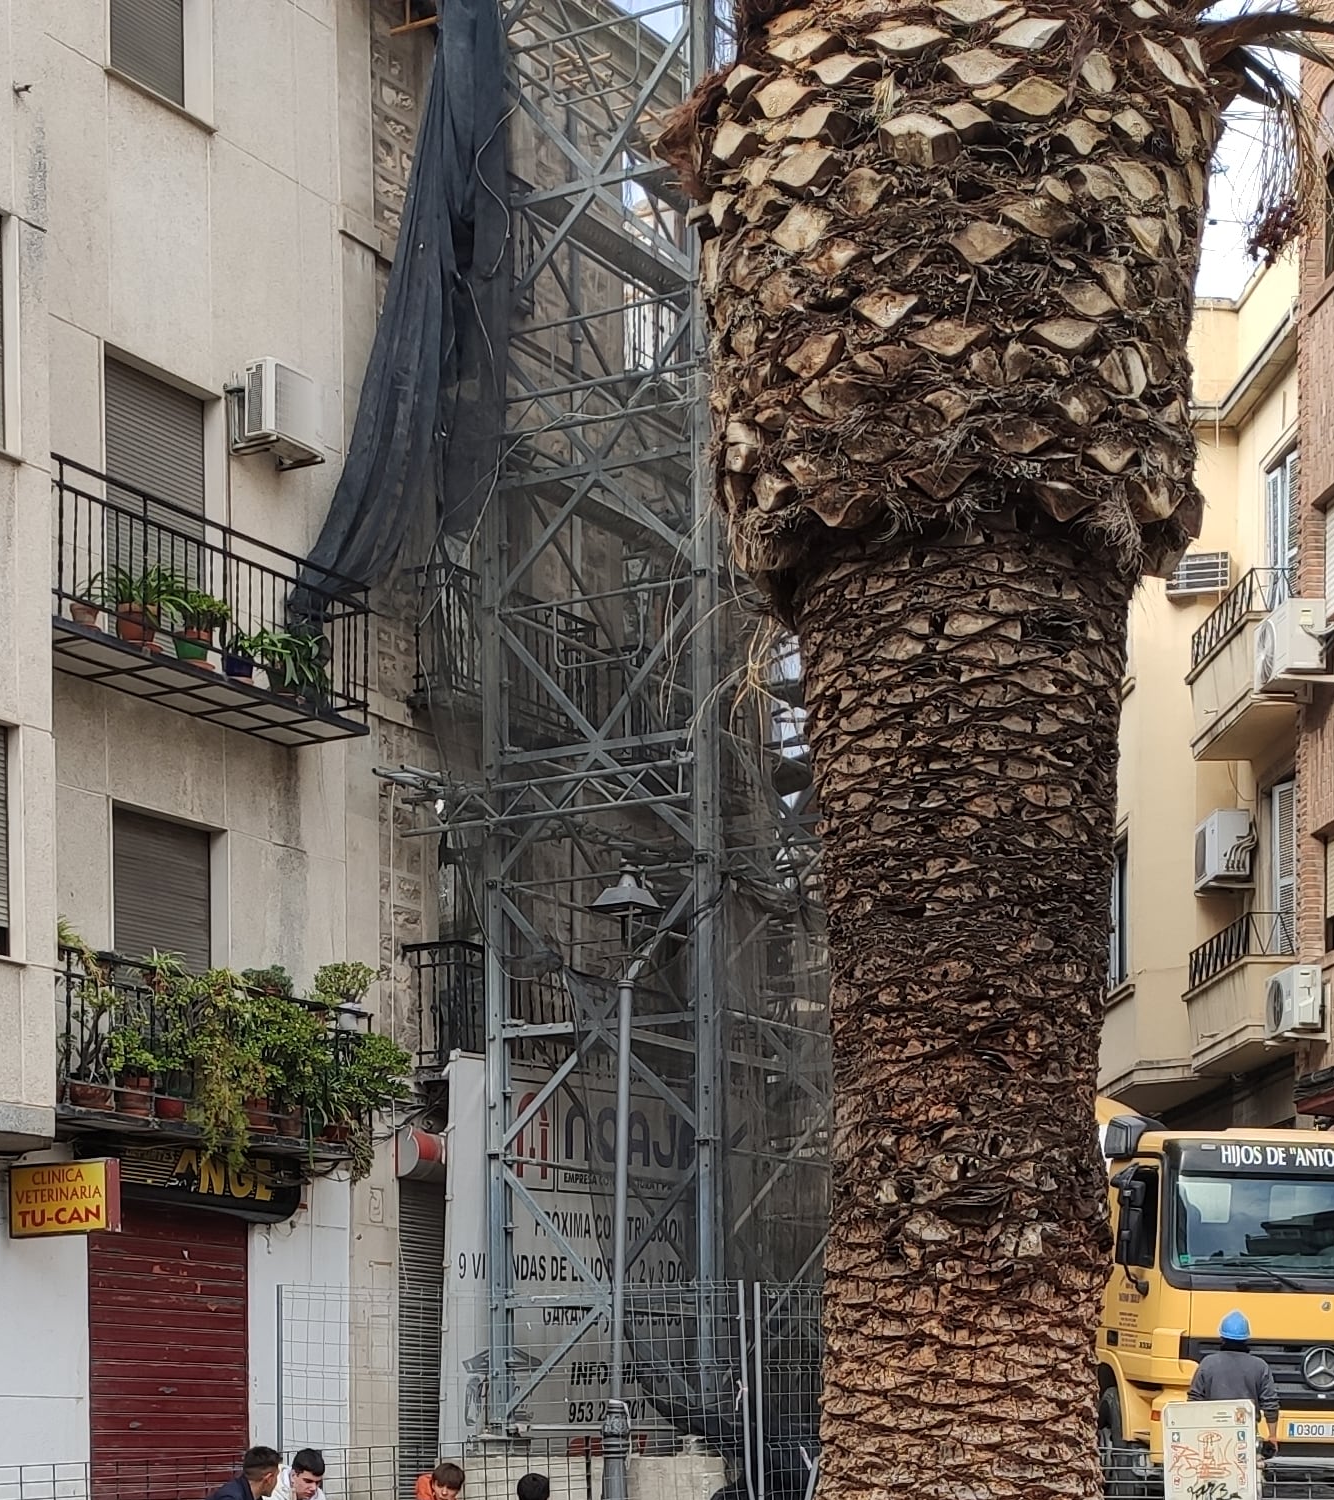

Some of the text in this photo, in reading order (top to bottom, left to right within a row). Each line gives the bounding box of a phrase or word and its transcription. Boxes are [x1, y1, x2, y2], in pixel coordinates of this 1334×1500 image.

[1220, 1144, 1263, 1167] HIJOS
[1266, 1146, 1287, 1166] DE
[31, 1168, 84, 1186] CLINICA
[563, 1172, 598, 1186] EMPRESA
[15, 1184, 102, 1205] VETERINARIA
[17, 1204, 101, 1229] TU-CAN
[457, 1252, 467, 1280] 9
[471, 1252, 547, 1282] VINDAS
[551, 1256, 568, 1282] DE
[568, 1401, 594, 1423] 953
[1296, 1424, 1325, 1436] 0300
